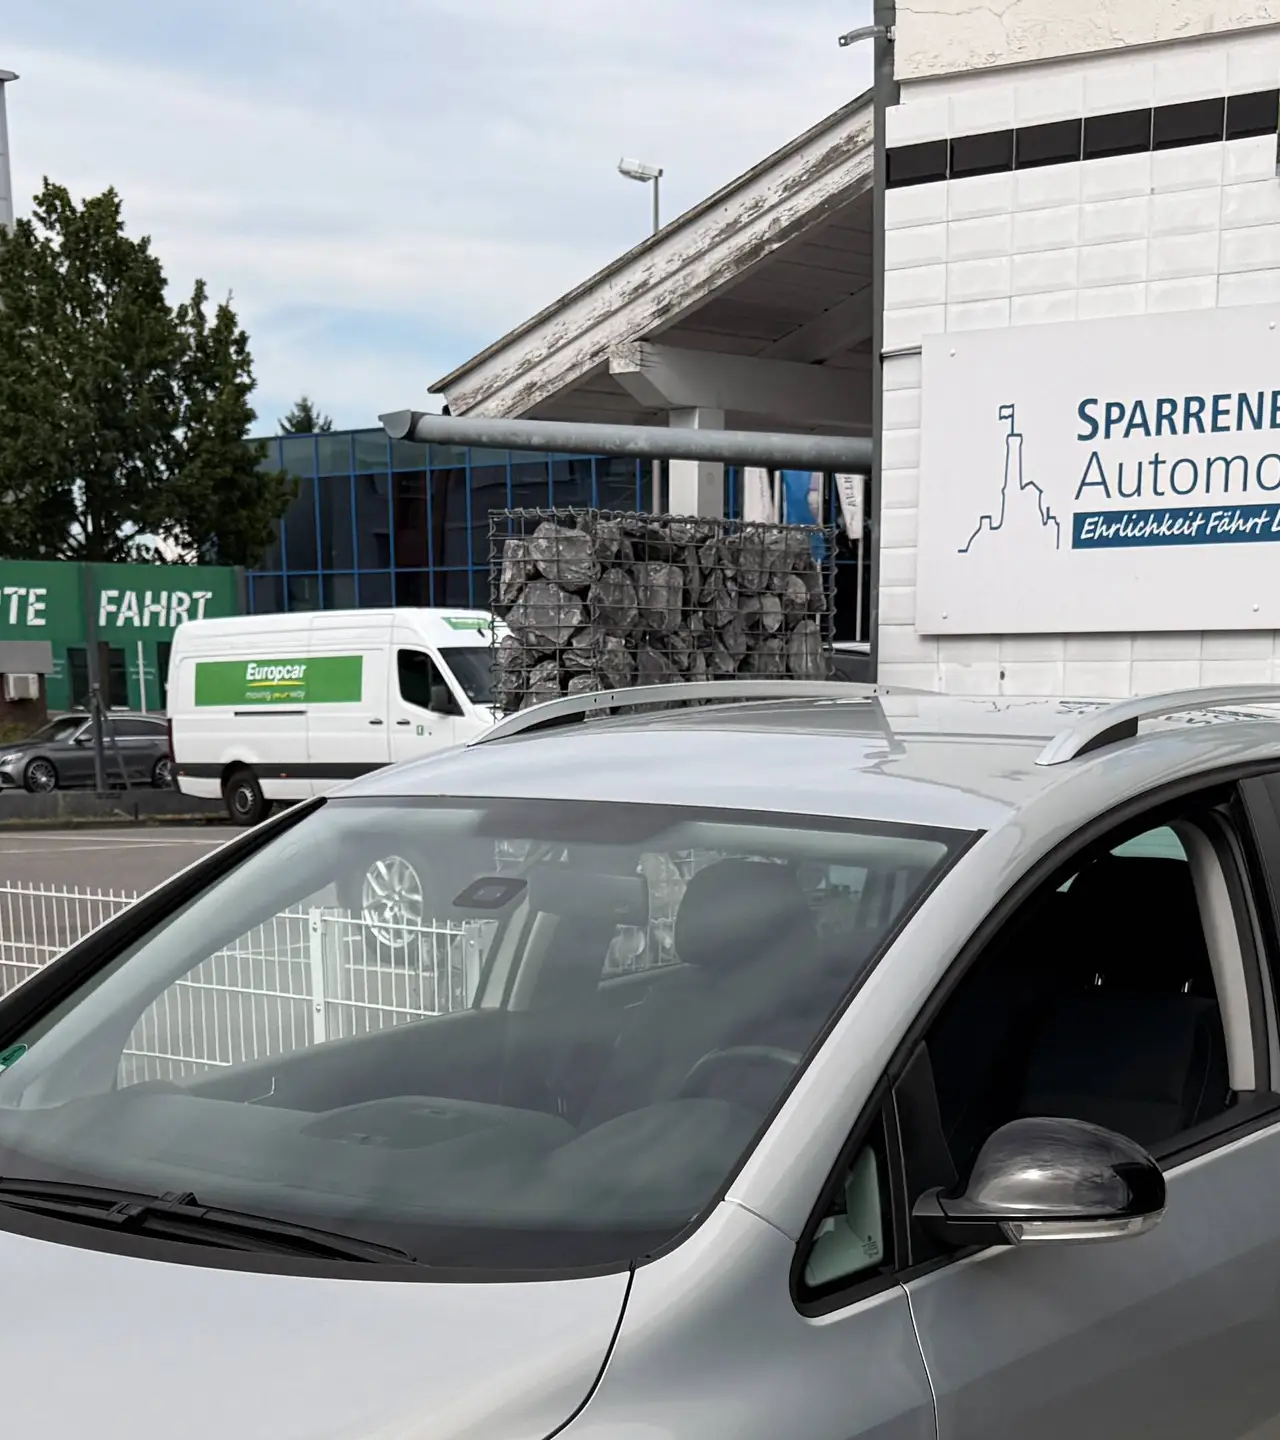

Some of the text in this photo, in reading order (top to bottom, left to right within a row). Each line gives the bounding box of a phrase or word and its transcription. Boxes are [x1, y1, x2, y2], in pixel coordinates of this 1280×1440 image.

[1080, 509, 1207, 540] Ehrlichkeit
[1206, 509, 1271, 536] Fährt
[98, 590, 213, 627] FAHRT
[246, 662, 307, 683] Europcar
